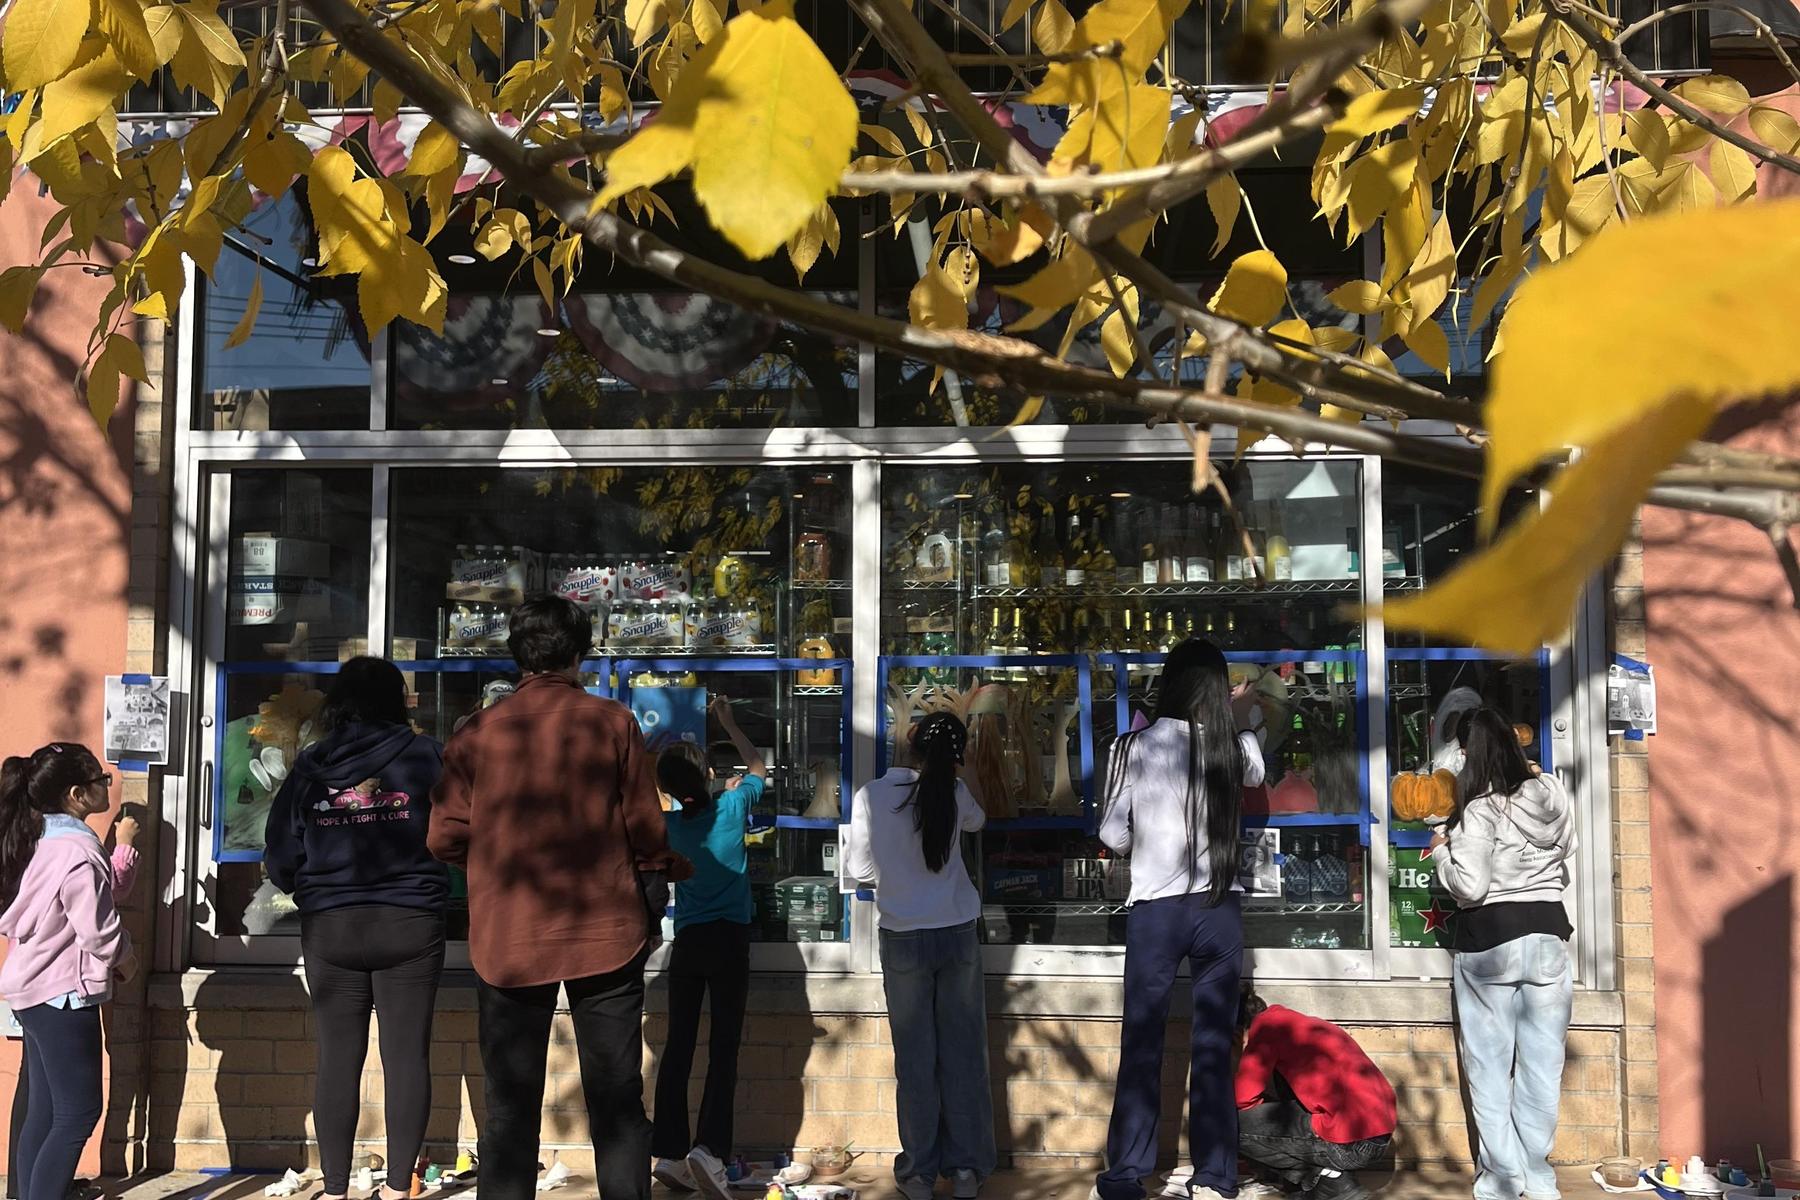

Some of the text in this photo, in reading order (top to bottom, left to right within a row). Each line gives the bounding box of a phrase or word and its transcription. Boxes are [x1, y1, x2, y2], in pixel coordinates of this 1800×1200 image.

[461, 564, 504, 582] Snapple
[633, 567, 674, 589] Snapple
[560, 574, 601, 592] Snapple
[462, 618, 505, 637] Snapple
[621, 617, 667, 638] Snapple
[699, 618, 742, 638] Snapple
[316, 810, 410, 826] HOPE FIGHT CURE
[1076, 860, 1105, 879] IPA
[1401, 900, 1411, 908] 12
